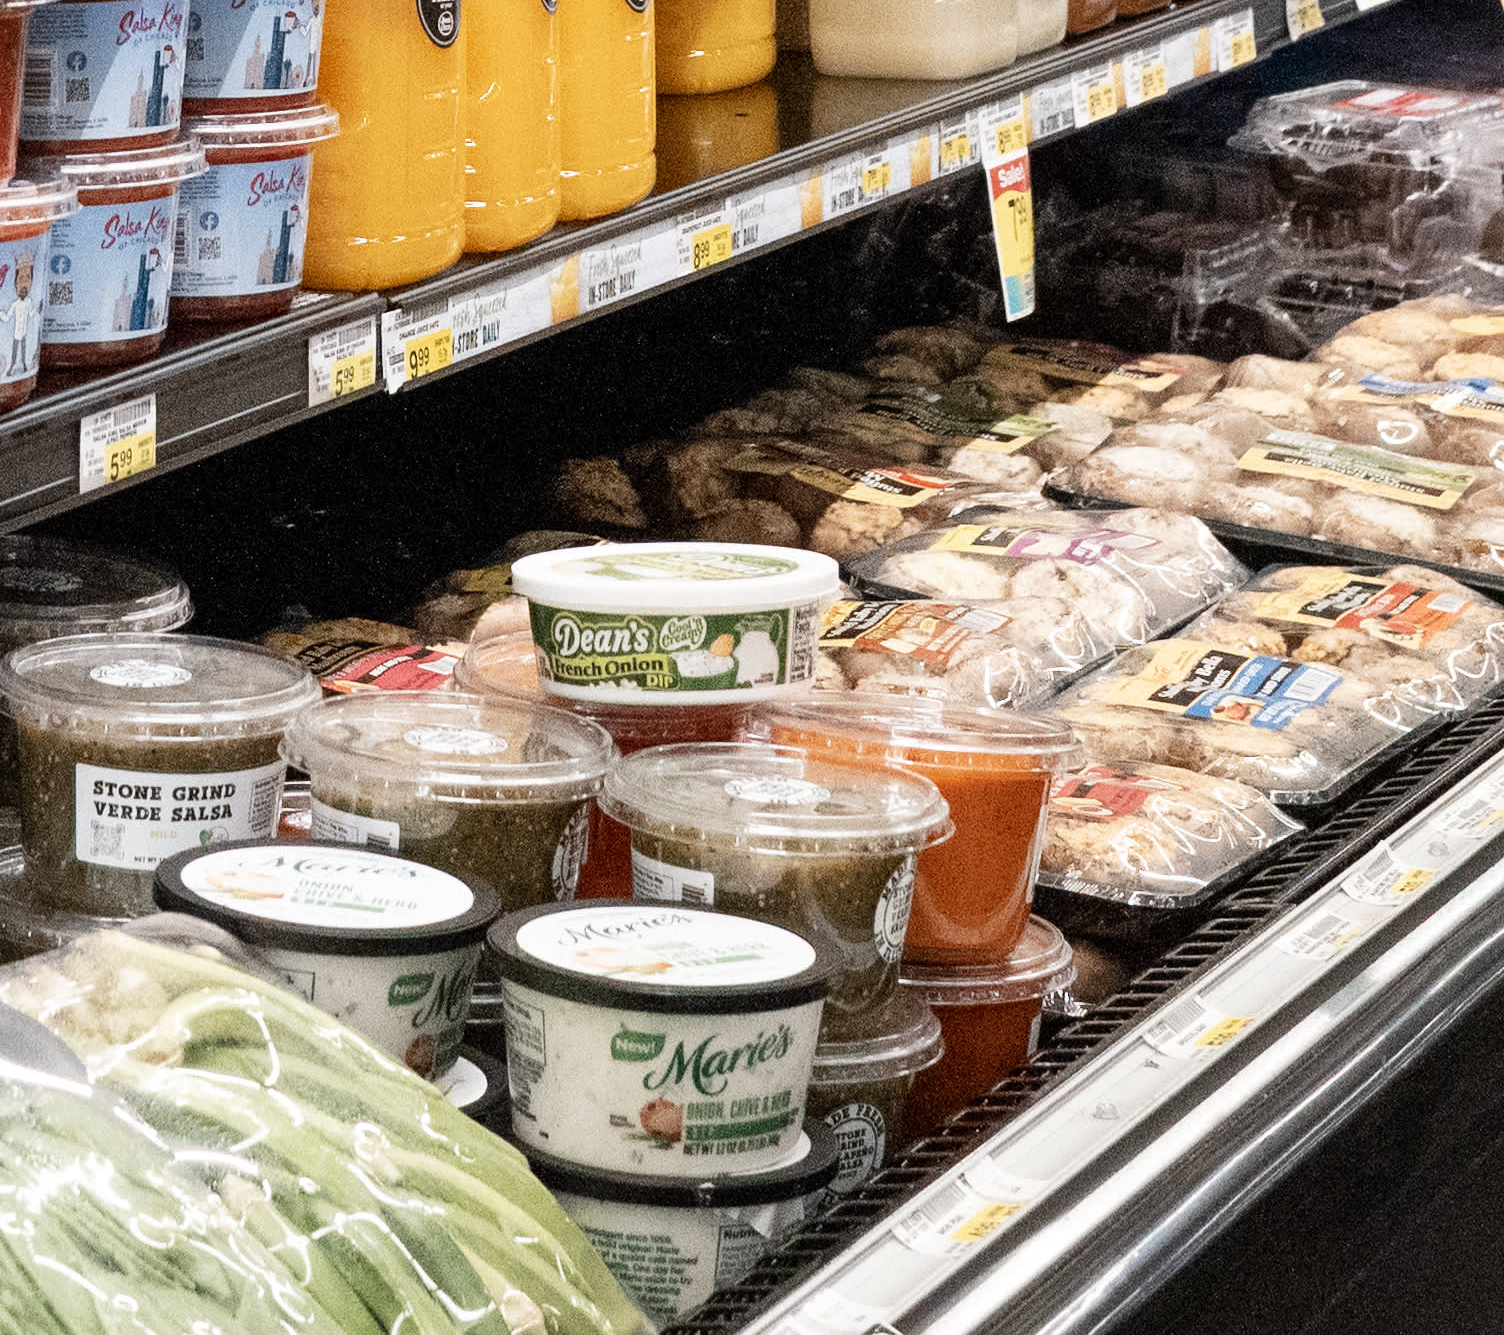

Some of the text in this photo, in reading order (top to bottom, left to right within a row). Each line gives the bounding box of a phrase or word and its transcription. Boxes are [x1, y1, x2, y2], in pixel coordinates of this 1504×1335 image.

[115, 10, 157, 47] Salsa
[997, 167, 1026, 188] Sale!
[247, 171, 285, 208] Salsa
[100, 213, 143, 250] Salsa
[619, 269, 636, 294] DAILY
[553, 616, 650, 658] Dean's
[554, 657, 665, 678] French Onion
[646, 675, 674, 689] DIP
[92, 779, 237, 801] STONE GRIND
[93, 800, 234, 822] VERDE SALSA
[614, 1036, 658, 1057] New!
[642, 1023, 793, 1098] Marie's
